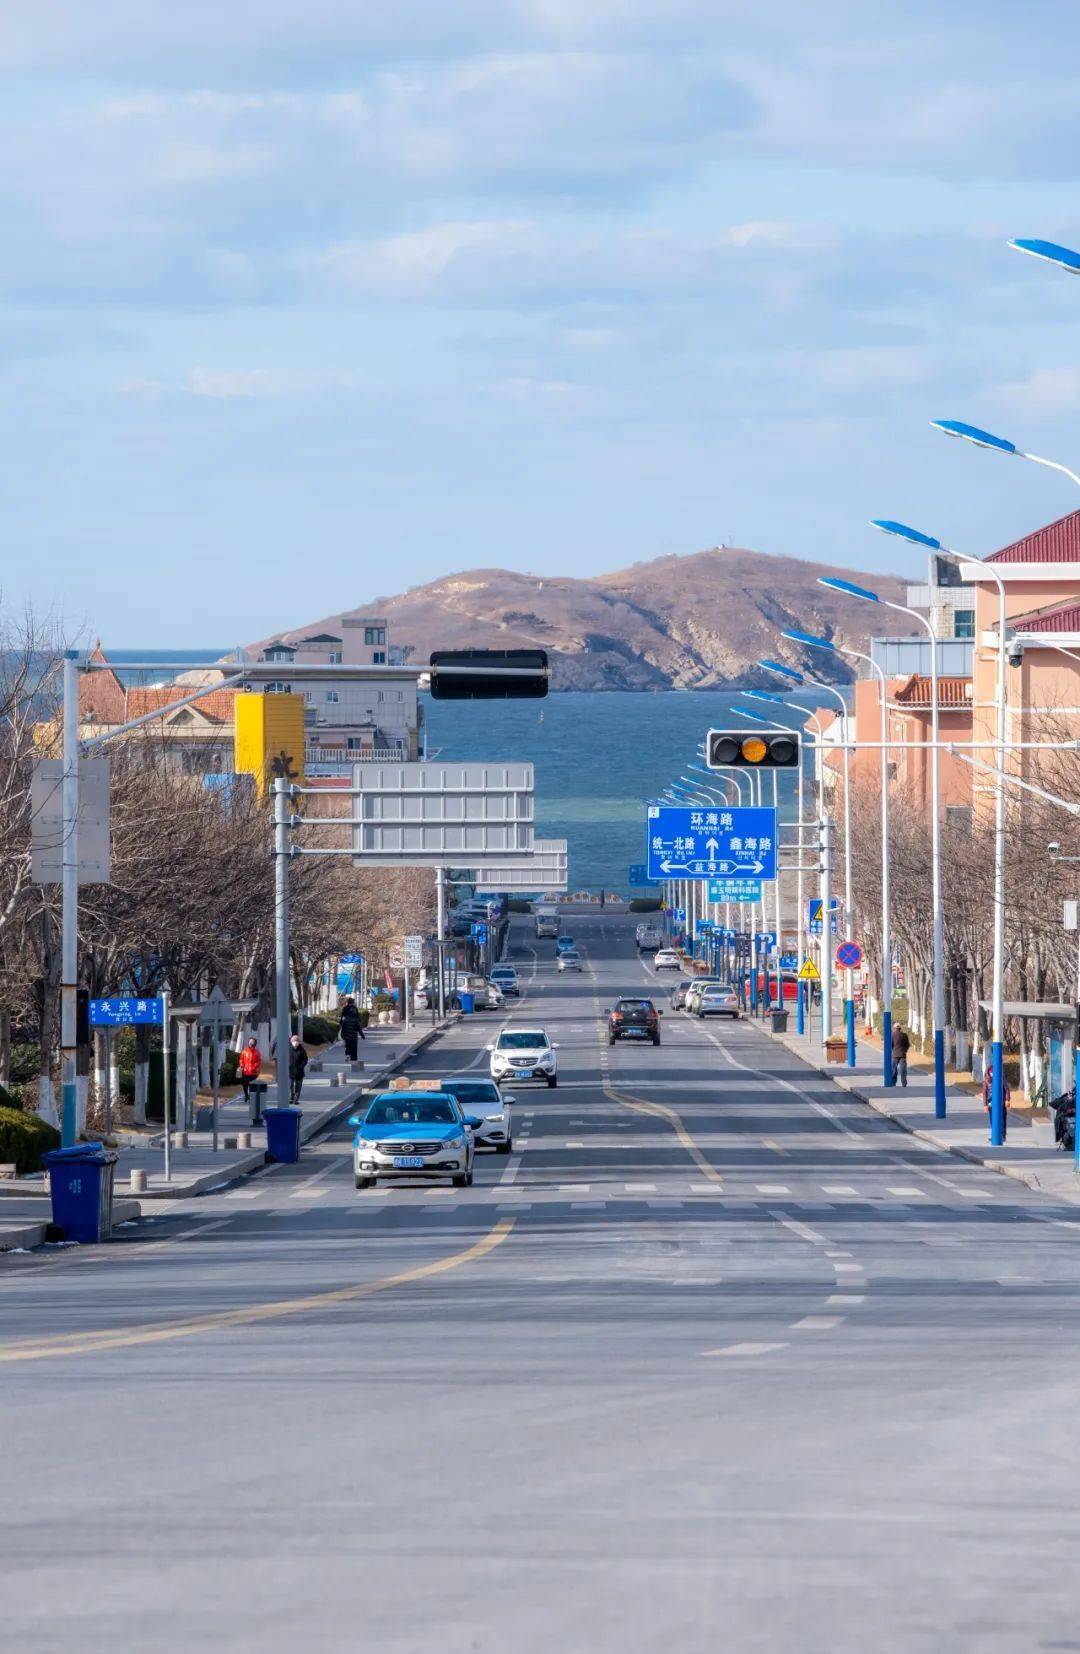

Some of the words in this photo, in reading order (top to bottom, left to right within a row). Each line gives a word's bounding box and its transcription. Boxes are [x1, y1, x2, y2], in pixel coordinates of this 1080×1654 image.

[691, 812, 732, 825] 环海路
[652, 836, 696, 850] 统一北路
[729, 836, 772, 850] 鑫海路
[694, 862, 729, 872] 蓝海路
[101, 1001, 147, 1012] 永兴路
